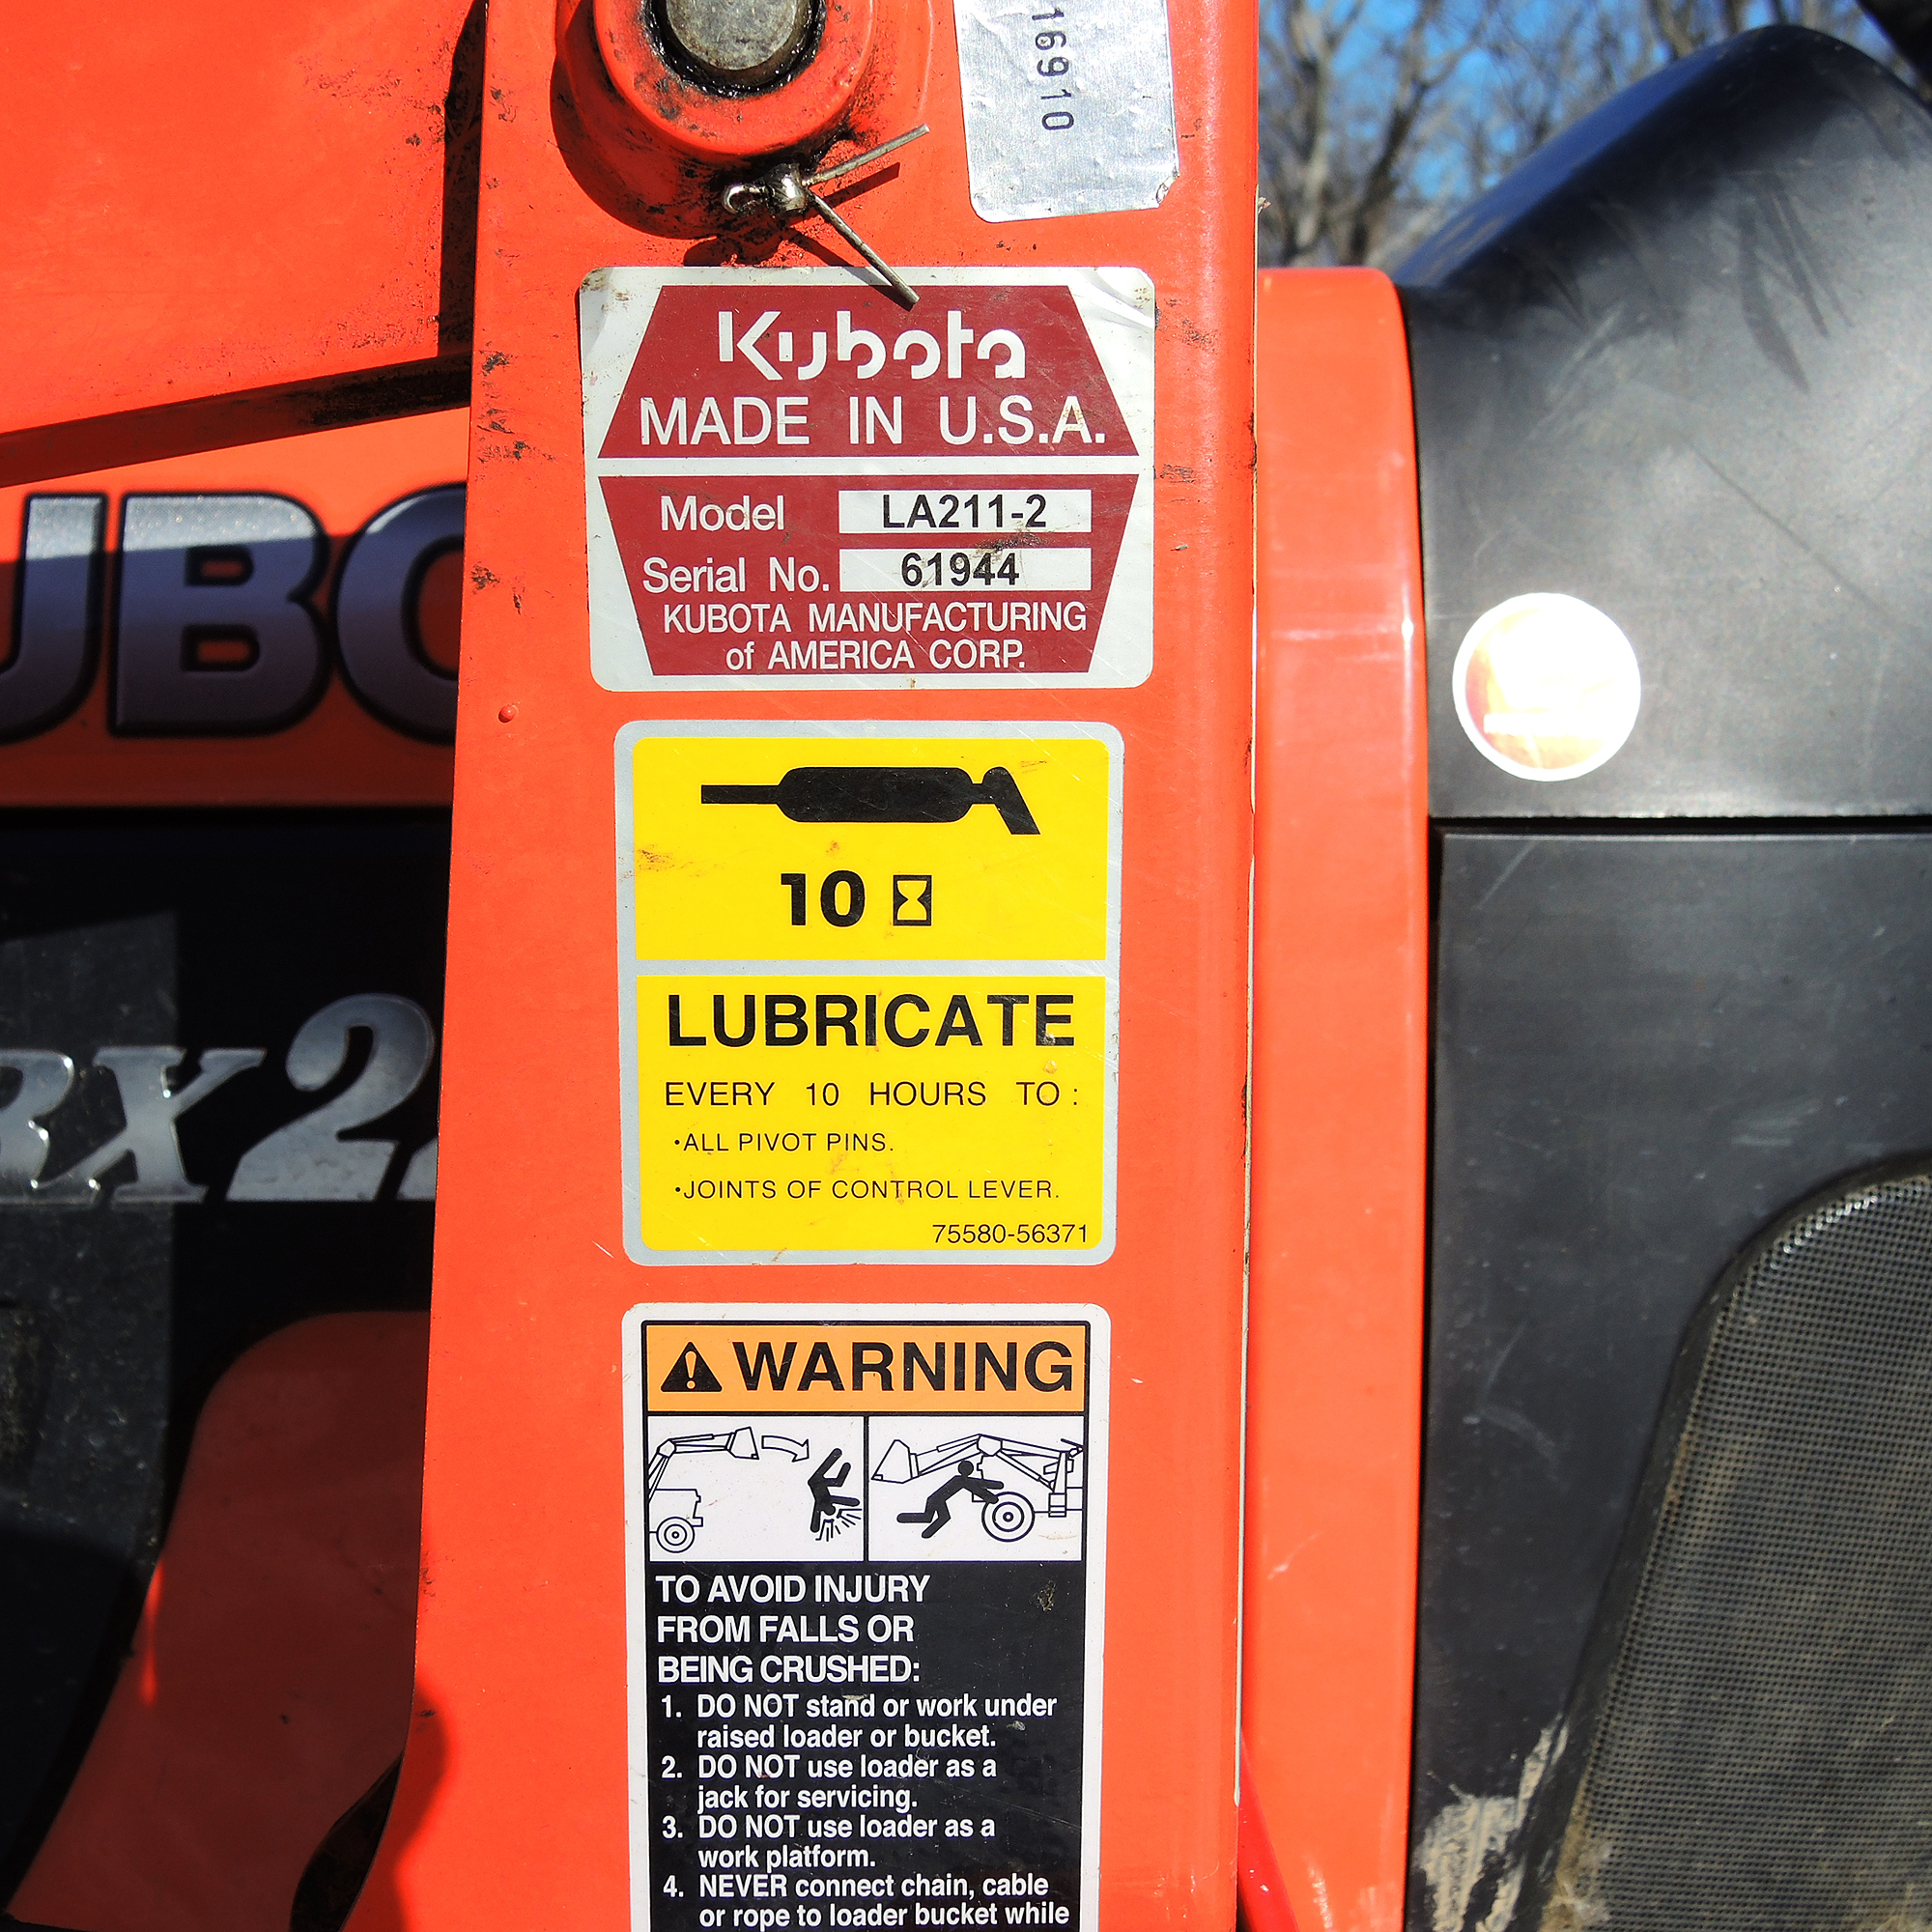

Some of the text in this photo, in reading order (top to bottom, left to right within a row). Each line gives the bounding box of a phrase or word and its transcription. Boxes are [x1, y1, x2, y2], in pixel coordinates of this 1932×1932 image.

[1031, 7, 1075, 131] 16910
[718, 309, 1027, 381] Kubota
[639, 395, 1106, 446] MADE IN U.S.A.
[660, 493, 1047, 531] Model LA211-2
[642, 552, 1020, 594] Serial No. 61944
[664, 601, 1087, 634] KUBOTA MANUFACTURING
[725, 639, 1026, 671] of AMERICA CORP.
[780, 869, 867, 928] 10
[668, 993, 1076, 1048] LUBRICATE
[665, 1082, 776, 1107] EVERY
[806, 1082, 840, 1107] 10
[869, 1081, 987, 1107] HOURS
[738, 1132, 817, 1152] PIVOT
[826, 1132, 895, 1152] PINS.
[786, 1179, 822, 1200] OF
[831, 1179, 959, 1200] CONTROL
[968, 1179, 1061, 1199] LEVER.
[932, 1223, 1088, 1244] 75580-56371
[732, 1341, 1074, 1393] WARNING
[707, 1575, 808, 1604] AVOID
[814, 1574, 931, 1604] INJURY
[657, 1614, 915, 1644] FROM FALLS OR
[657, 1655, 921, 1685] BEING CRUSHED:
[661, 1693, 1058, 1719] 1. DO NOT stand or work under
[696, 1723, 996, 1749] raised loader or bucket.
[661, 1753, 997, 1779] 2. DO NOT use loader as a
[696, 1783, 919, 1816] jack for servicing.
[662, 1813, 996, 1839] 3. DO NOT use loader as a
[697, 1843, 877, 1875] work platform.
[663, 1872, 1049, 1902] 4. NEVER connect chain, cable
[698, 1902, 1070, 1932] or rope to loader bucket while
